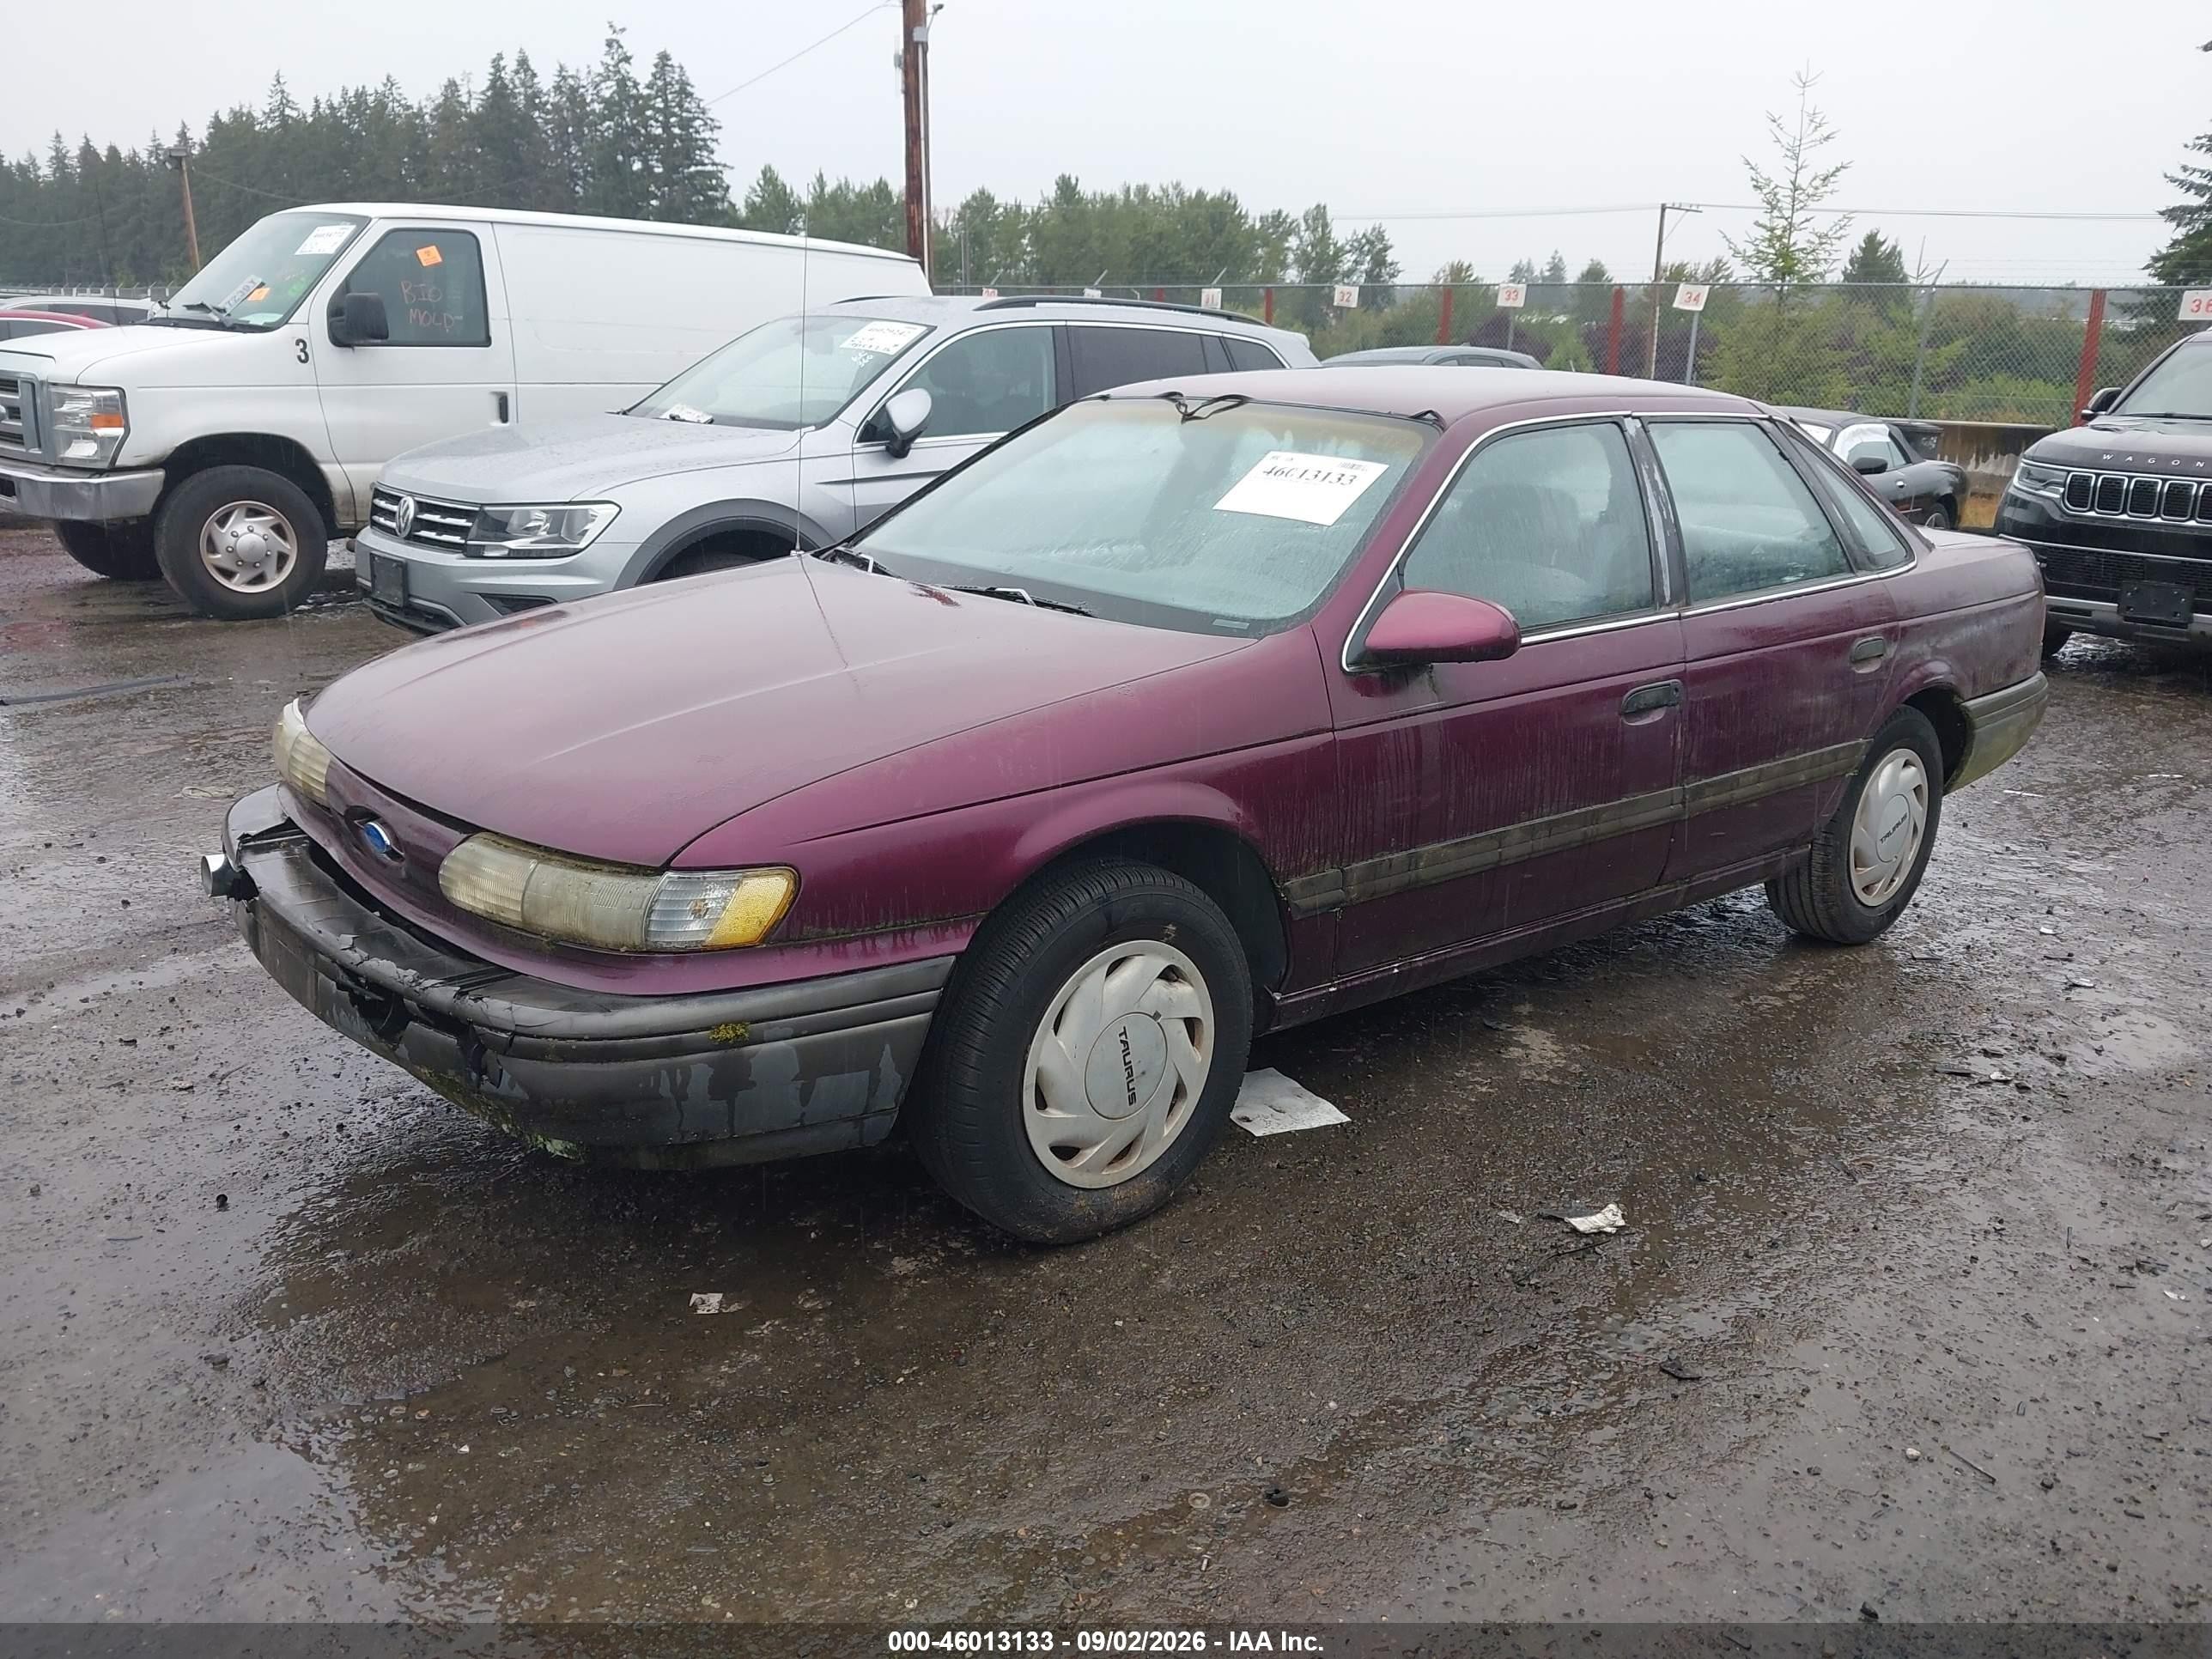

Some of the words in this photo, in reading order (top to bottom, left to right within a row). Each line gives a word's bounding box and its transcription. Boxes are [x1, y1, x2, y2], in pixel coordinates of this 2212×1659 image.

[400, 280, 442, 304] BIO
[1339, 291, 1352, 302] 32
[1504, 288, 1519, 301] 33
[1684, 291, 1701, 306] 34
[295, 338, 310, 364] 3
[1118, 1025, 1137, 1107] TAURUS
